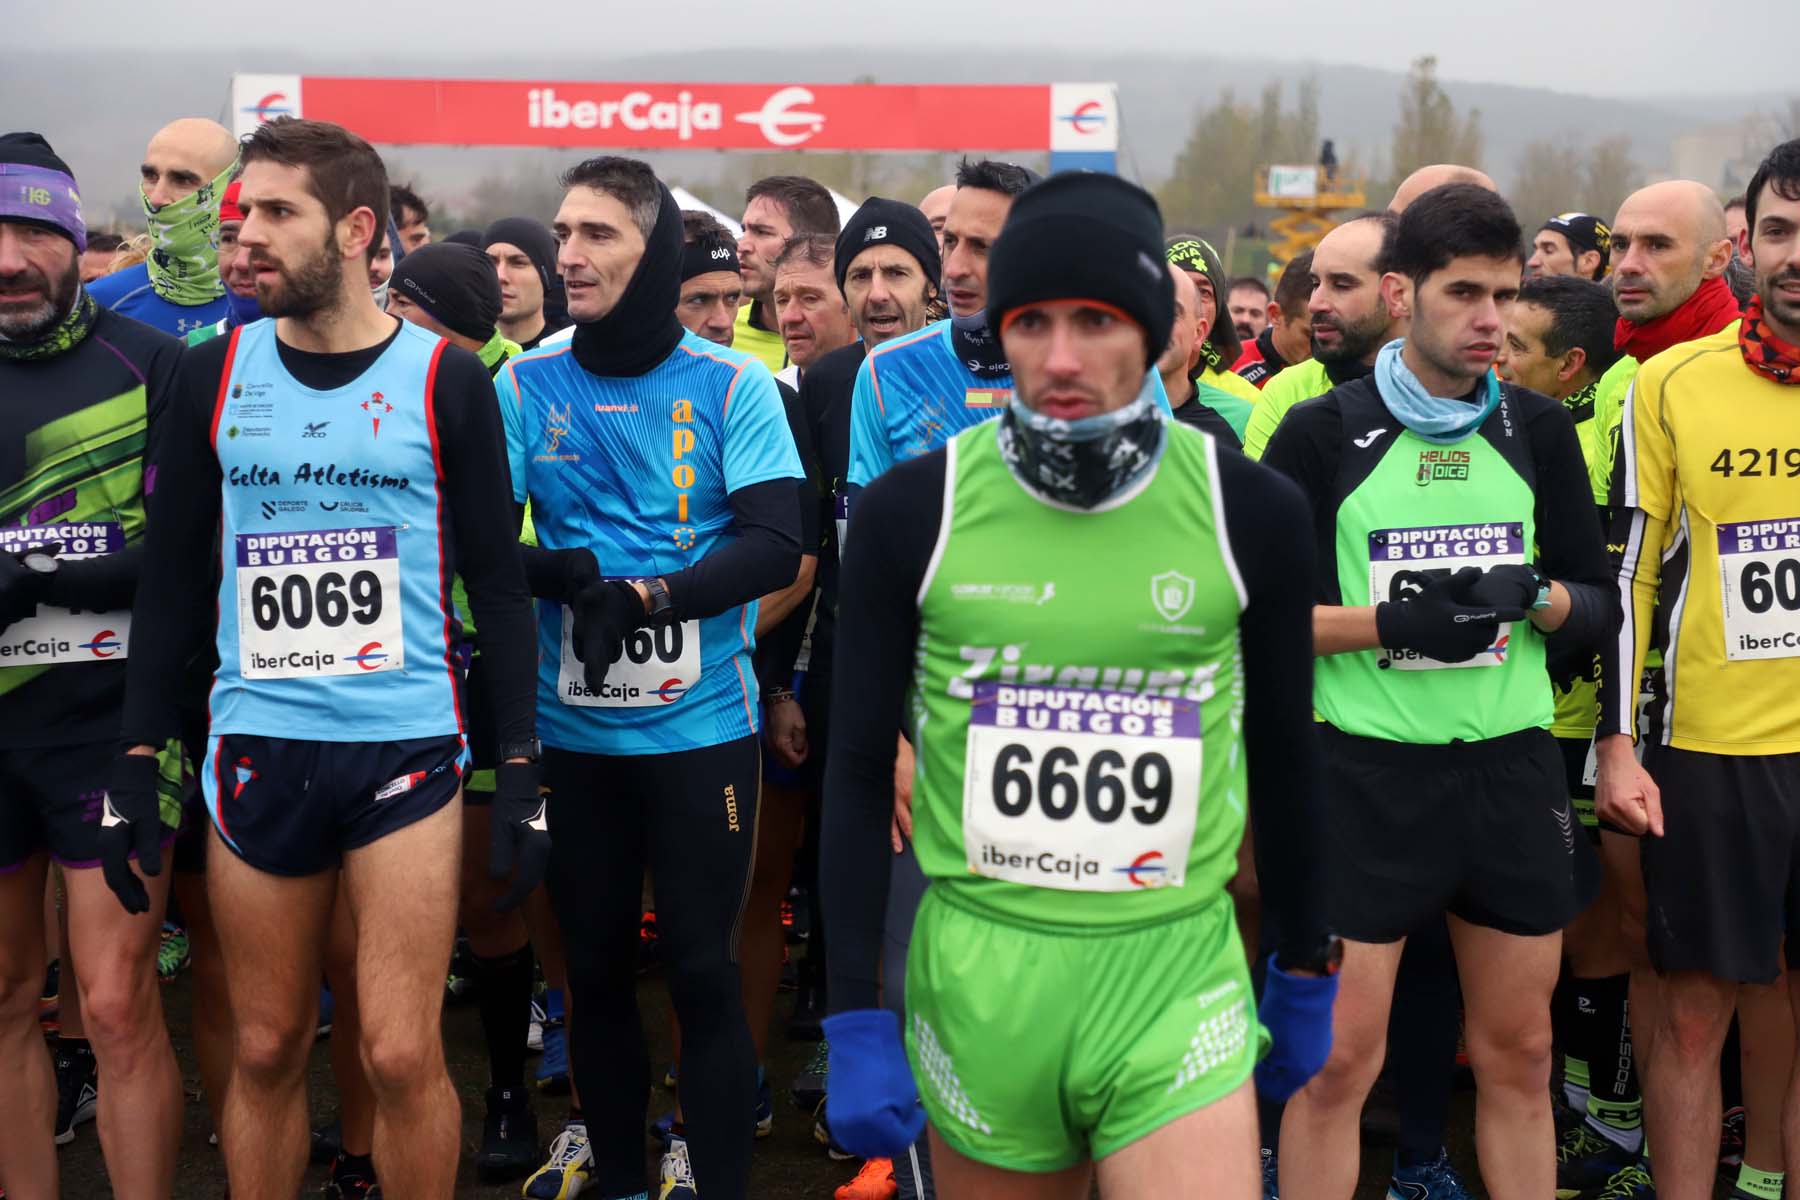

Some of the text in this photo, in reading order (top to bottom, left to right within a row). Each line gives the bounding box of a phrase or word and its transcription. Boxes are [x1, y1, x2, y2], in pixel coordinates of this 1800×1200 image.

[528, 89, 722, 140] iberCaja
[864, 226, 887, 241] NB
[988, 361, 1011, 373] Caja
[230, 463, 409, 490] Celta Atletismo
[247, 529, 377, 550] DIPUTACIÓN
[1388, 524, 1507, 544] DIPUTACIÓN
[247, 545, 378, 566] BURGOS
[1388, 539, 1509, 560] BURGOS
[1740, 558, 1800, 614] 60
[251, 570, 383, 632] 6069
[251, 651, 335, 671] iberCaja
[567, 681, 640, 702] ibeCaja
[997, 687, 1175, 717] DIPUTACIÓN
[996, 707, 1174, 738] BURGOS
[992, 743, 1173, 826] 6669
[981, 845, 1099, 881] iberCaja
